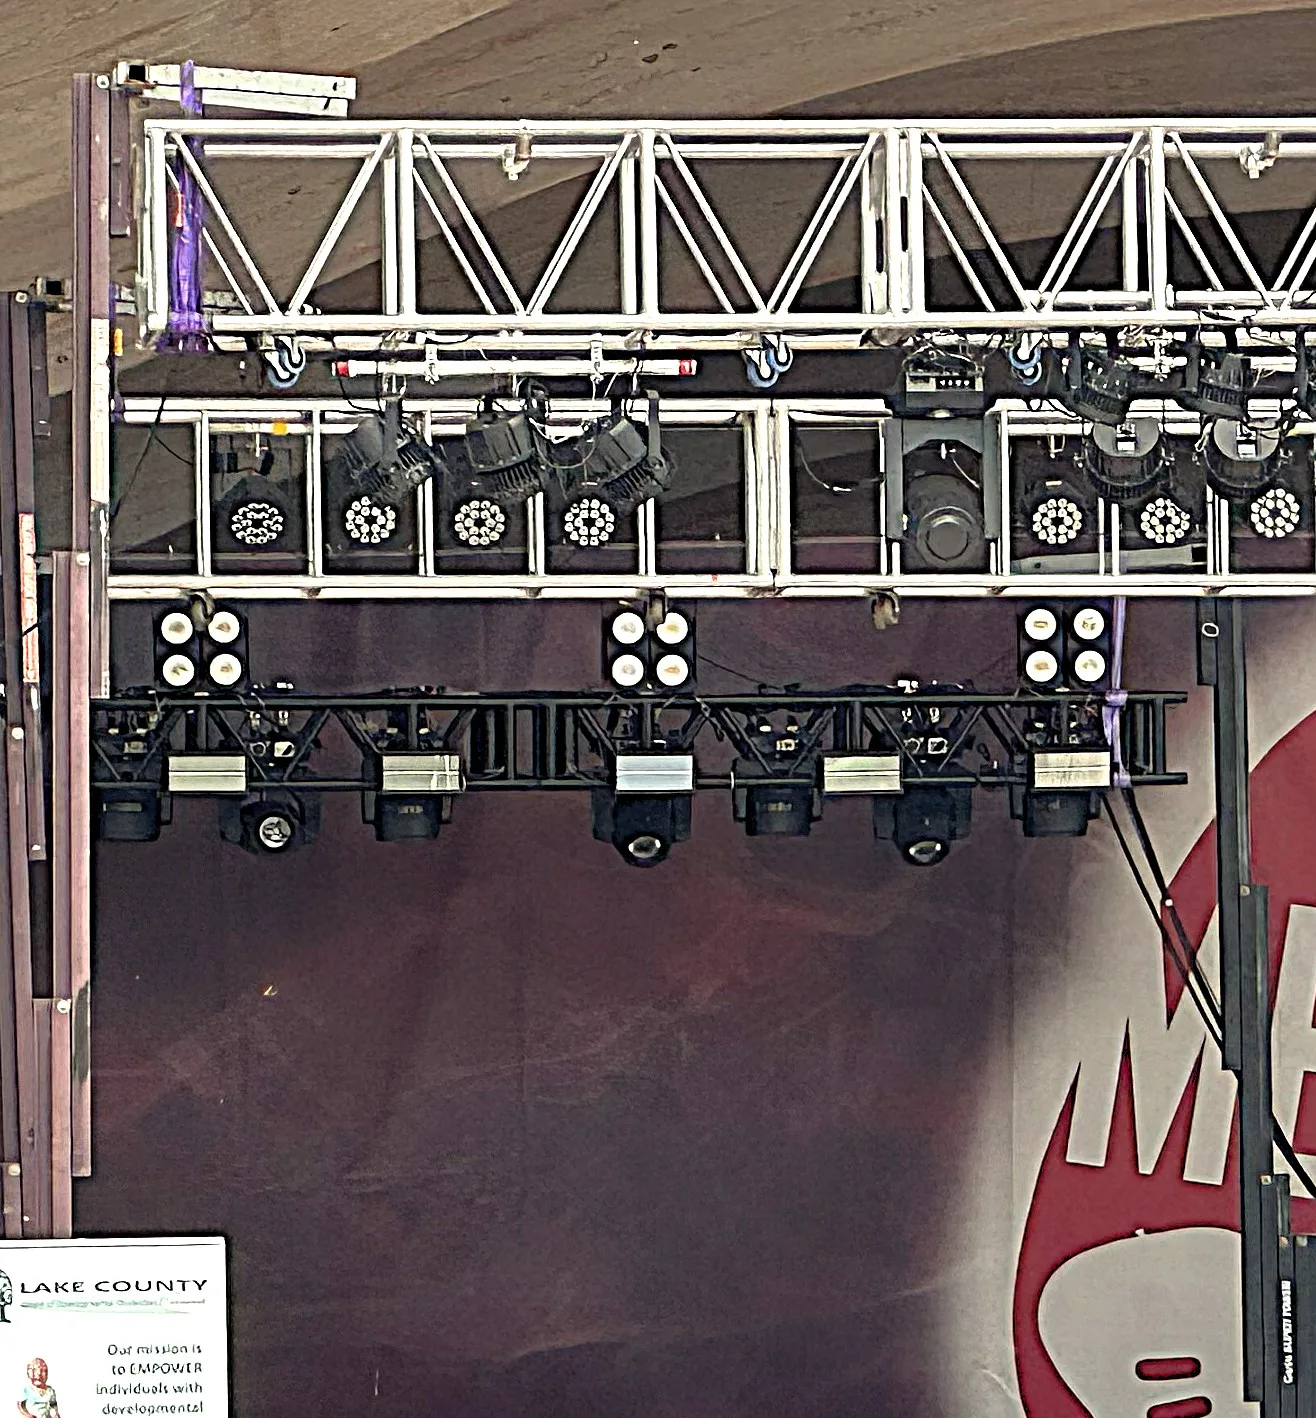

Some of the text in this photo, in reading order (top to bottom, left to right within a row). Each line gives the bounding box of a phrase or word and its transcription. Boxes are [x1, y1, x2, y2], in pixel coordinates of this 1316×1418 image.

[20, 1280, 207, 1293] LAKE COUNTY
[108, 1344, 202, 1355] Our mission is
[112, 1363, 203, 1375] to EMPOWER
[96, 1382, 203, 1395] individuals with
[102, 1401, 203, 1416] developmental
